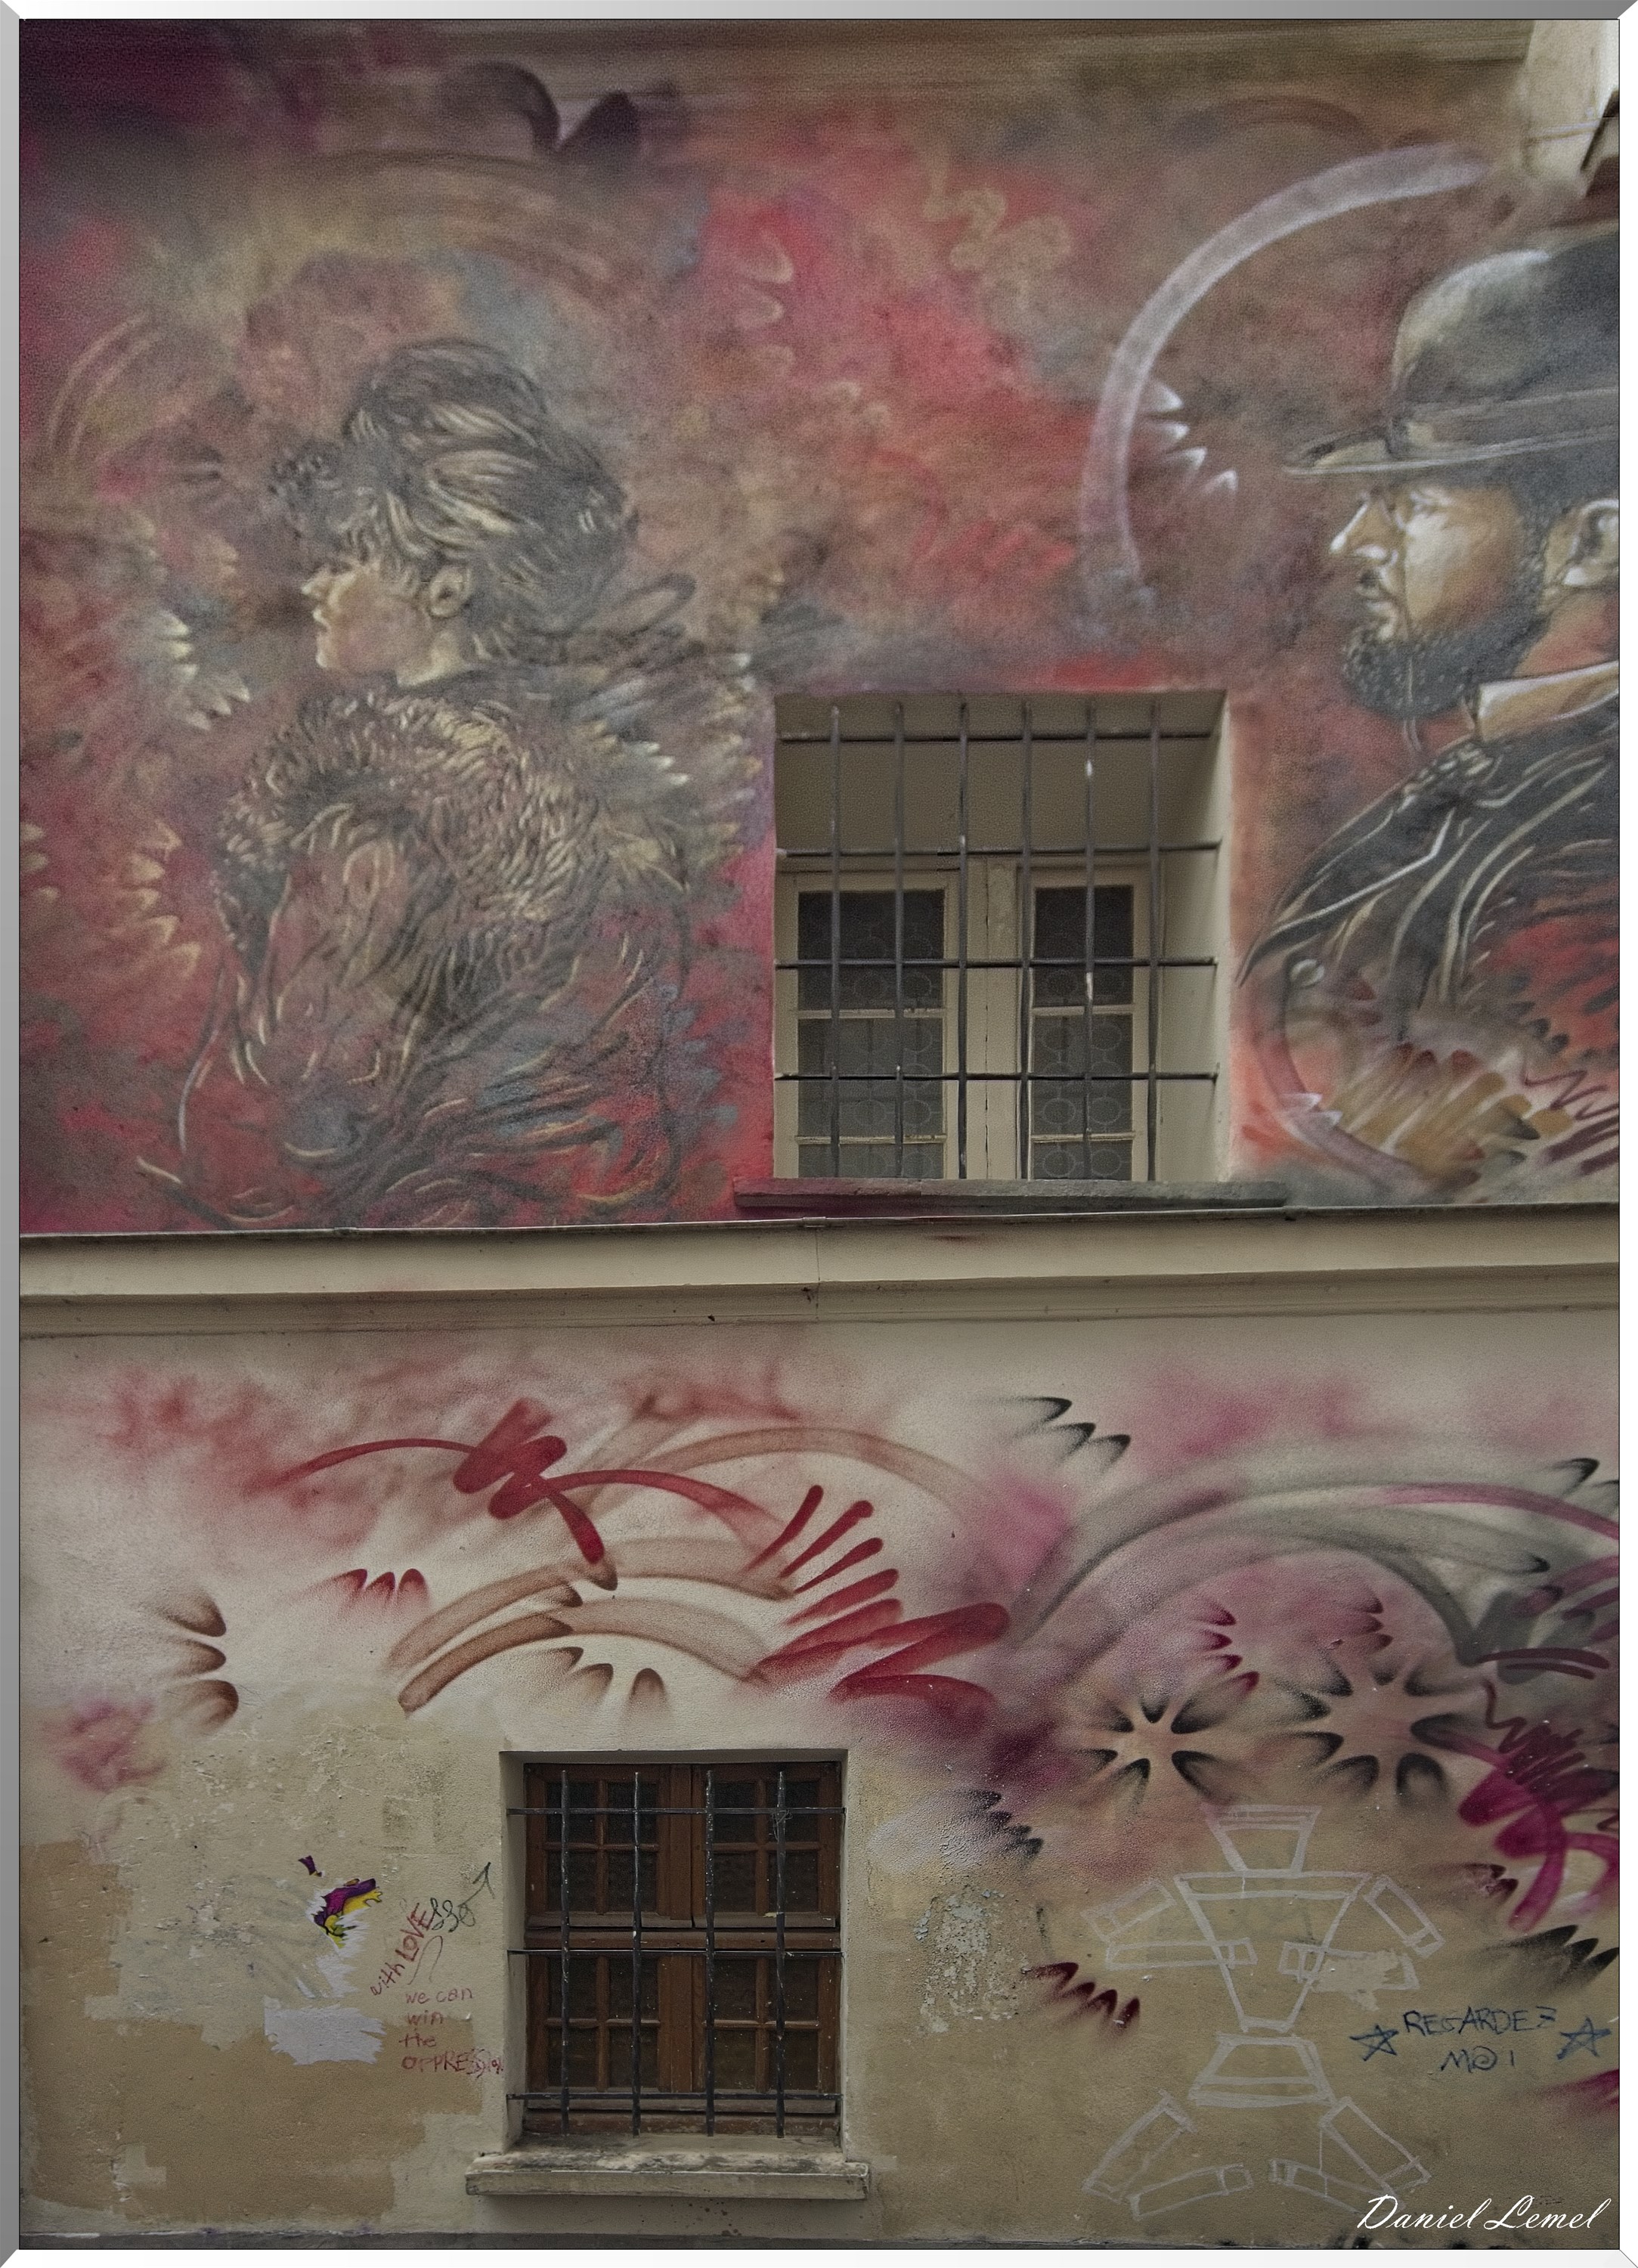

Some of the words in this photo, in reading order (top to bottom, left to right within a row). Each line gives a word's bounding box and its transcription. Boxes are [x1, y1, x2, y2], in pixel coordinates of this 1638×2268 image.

[370, 1962, 405, 1996] with
[395, 1902, 435, 1962] LOVE
[406, 1990, 430, 2004] we
[436, 1987, 473, 2003] can
[407, 2009, 444, 2025] win
[398, 2028, 437, 2047] the
